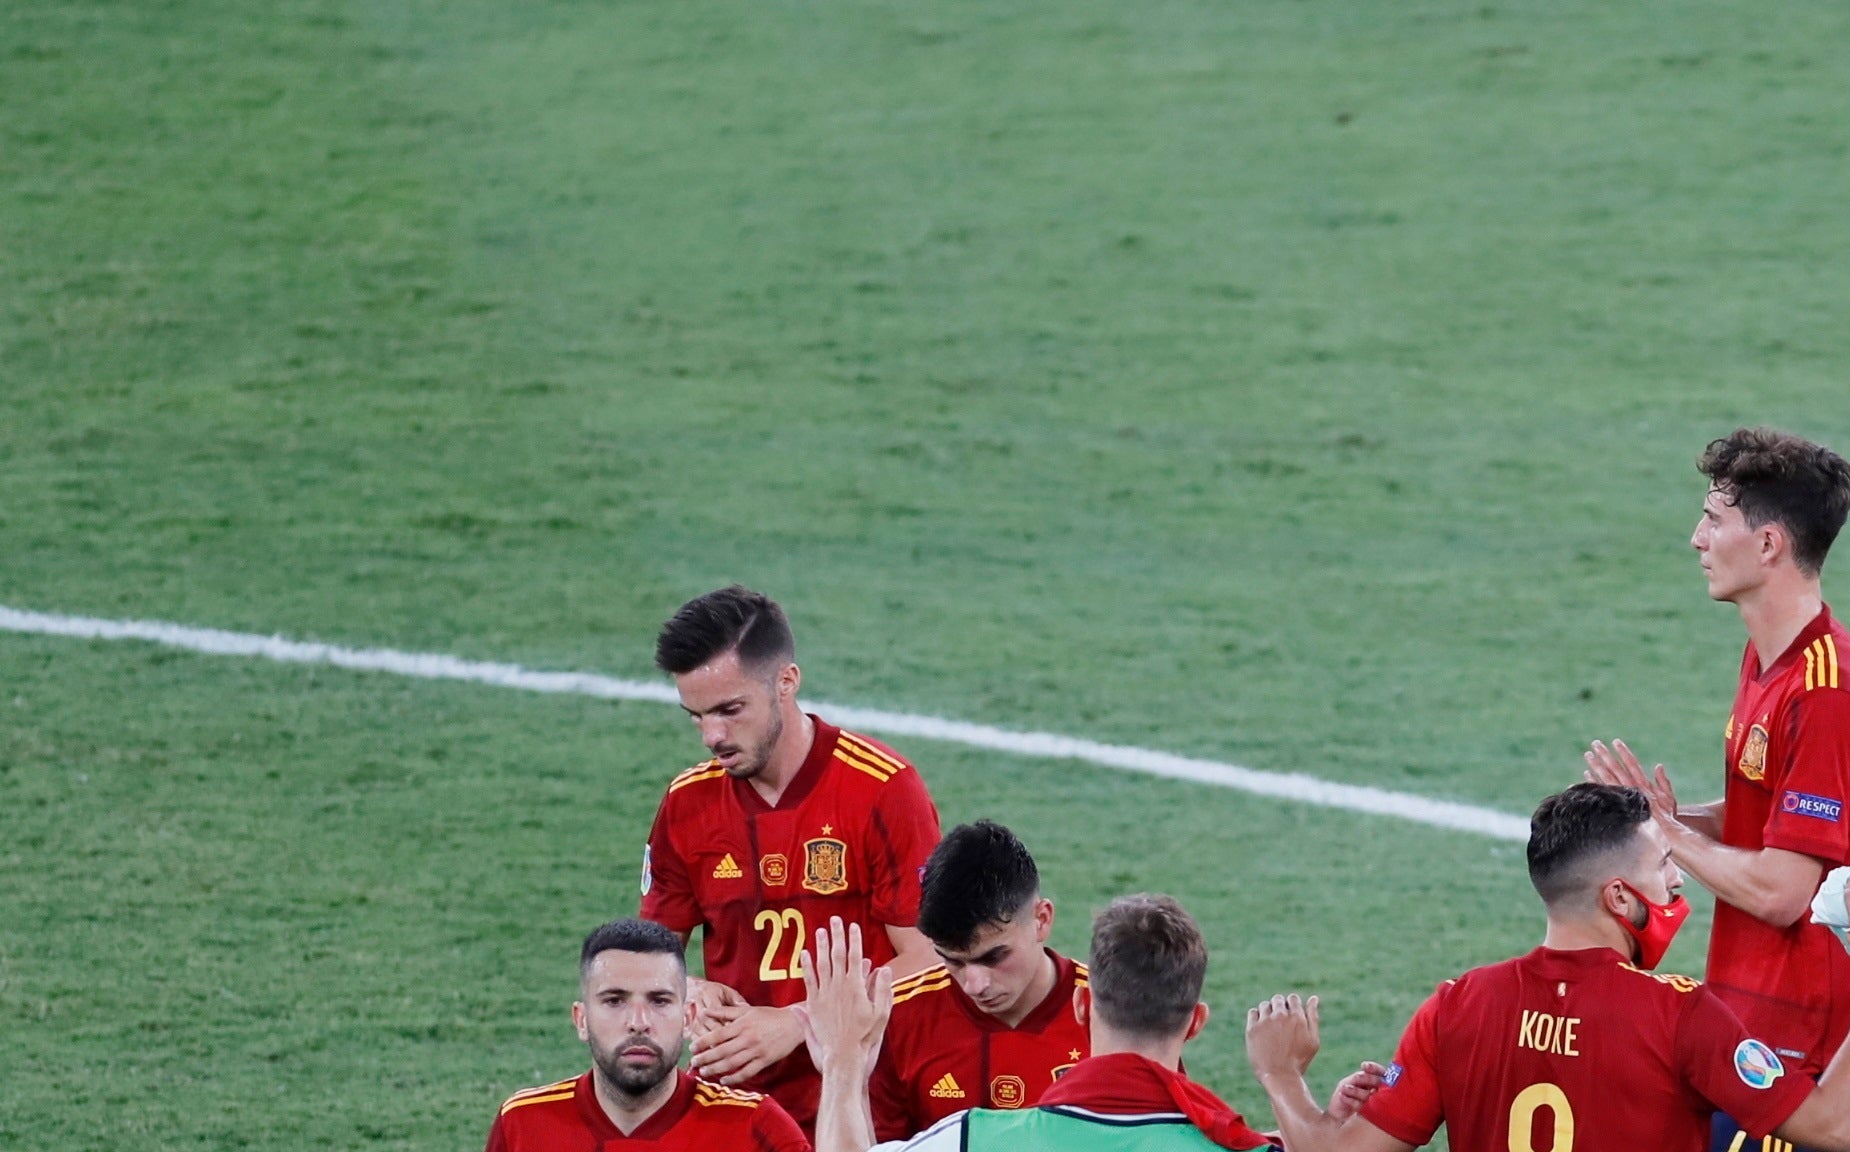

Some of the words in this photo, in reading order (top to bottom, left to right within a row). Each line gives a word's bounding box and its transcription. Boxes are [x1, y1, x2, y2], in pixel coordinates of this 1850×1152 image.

[1799, 799, 1841, 816] RESPECT
[713, 869, 743, 879] adidas
[754, 908, 805, 982] 22
[1518, 1009, 1581, 1057] KOKE
[929, 1088, 966, 1099] adidas
